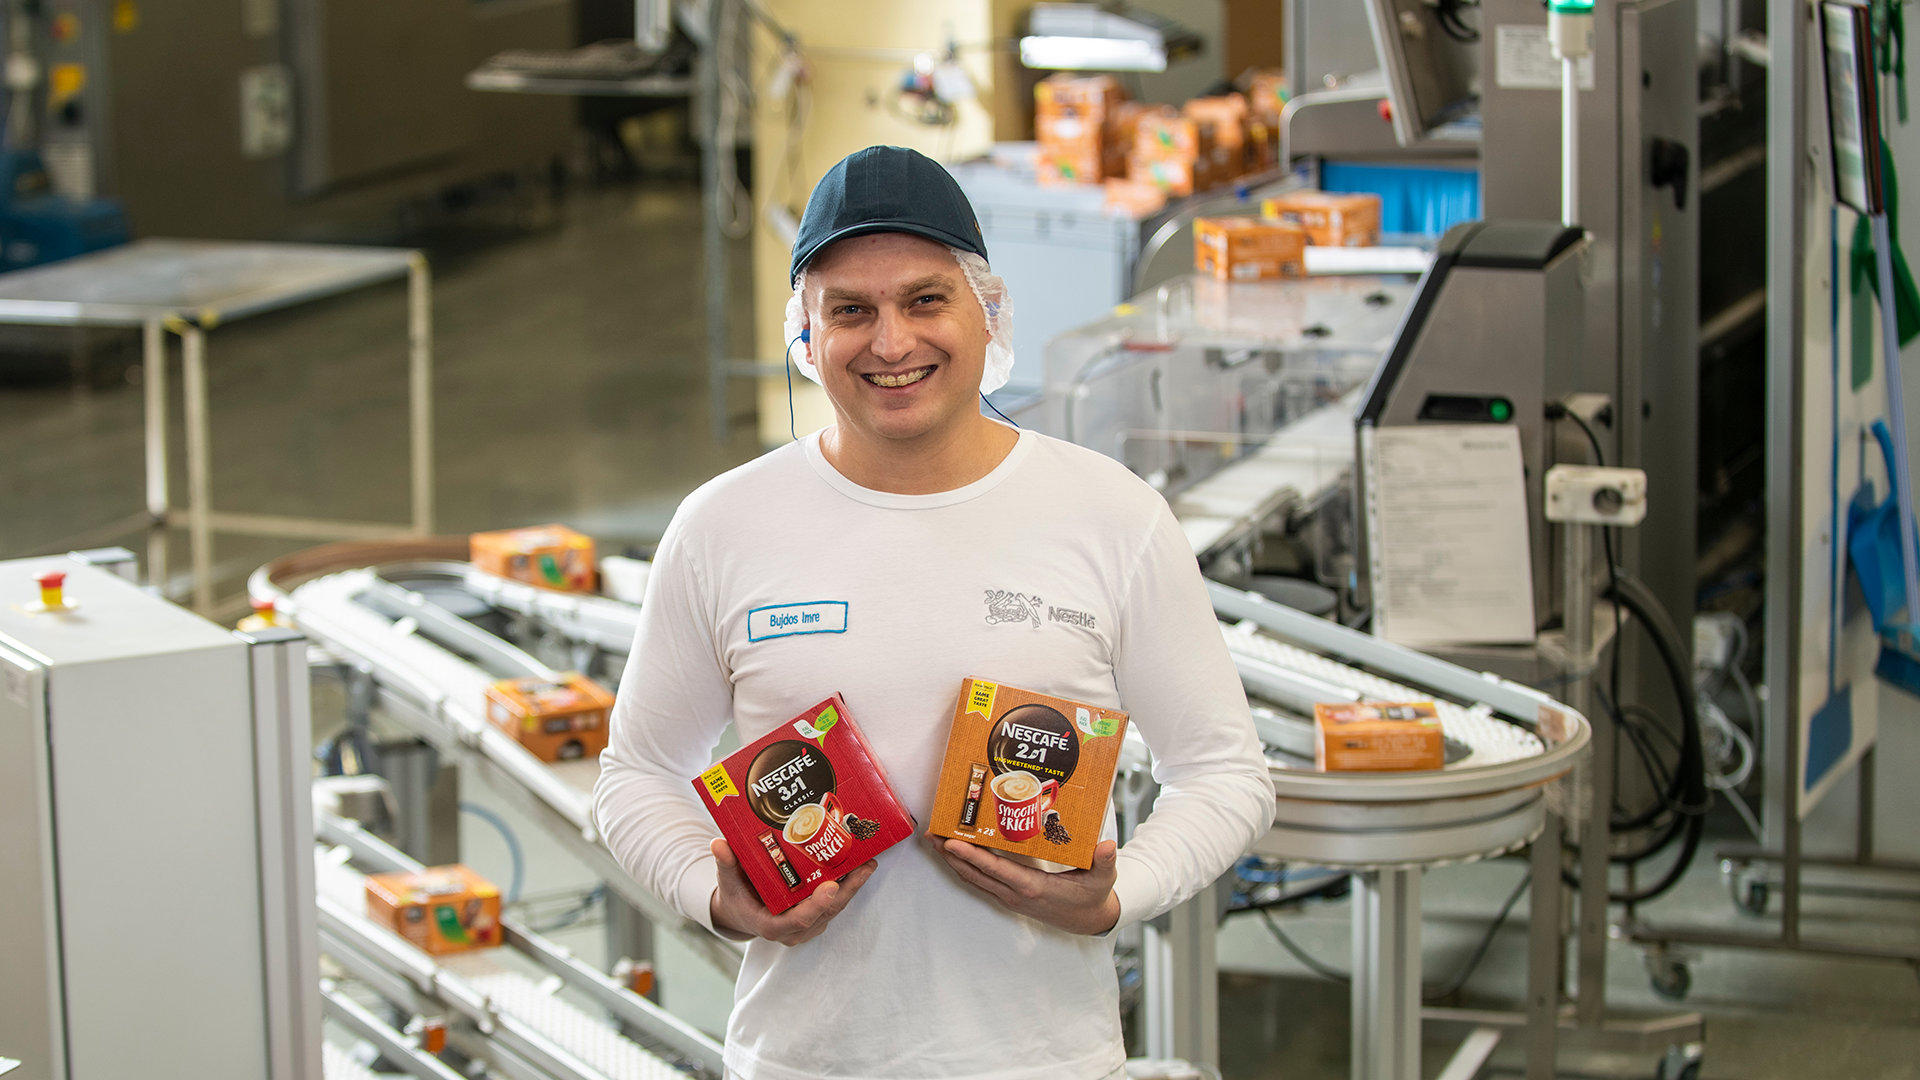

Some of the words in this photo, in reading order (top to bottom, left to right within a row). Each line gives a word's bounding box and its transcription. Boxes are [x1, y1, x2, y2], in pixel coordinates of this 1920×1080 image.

[770, 613, 798, 629] Bujdos
[801, 611, 820, 624] Imre
[1044, 767, 1065, 777] TASTE
[710, 775, 723, 786] SAME
[713, 780, 726, 790] GREAT
[715, 784, 728, 794] TASTE
[783, 790, 815, 811] CLASSIC
[998, 802, 1038, 818] SMOOTH
[805, 820, 836, 855] SMOOTH
